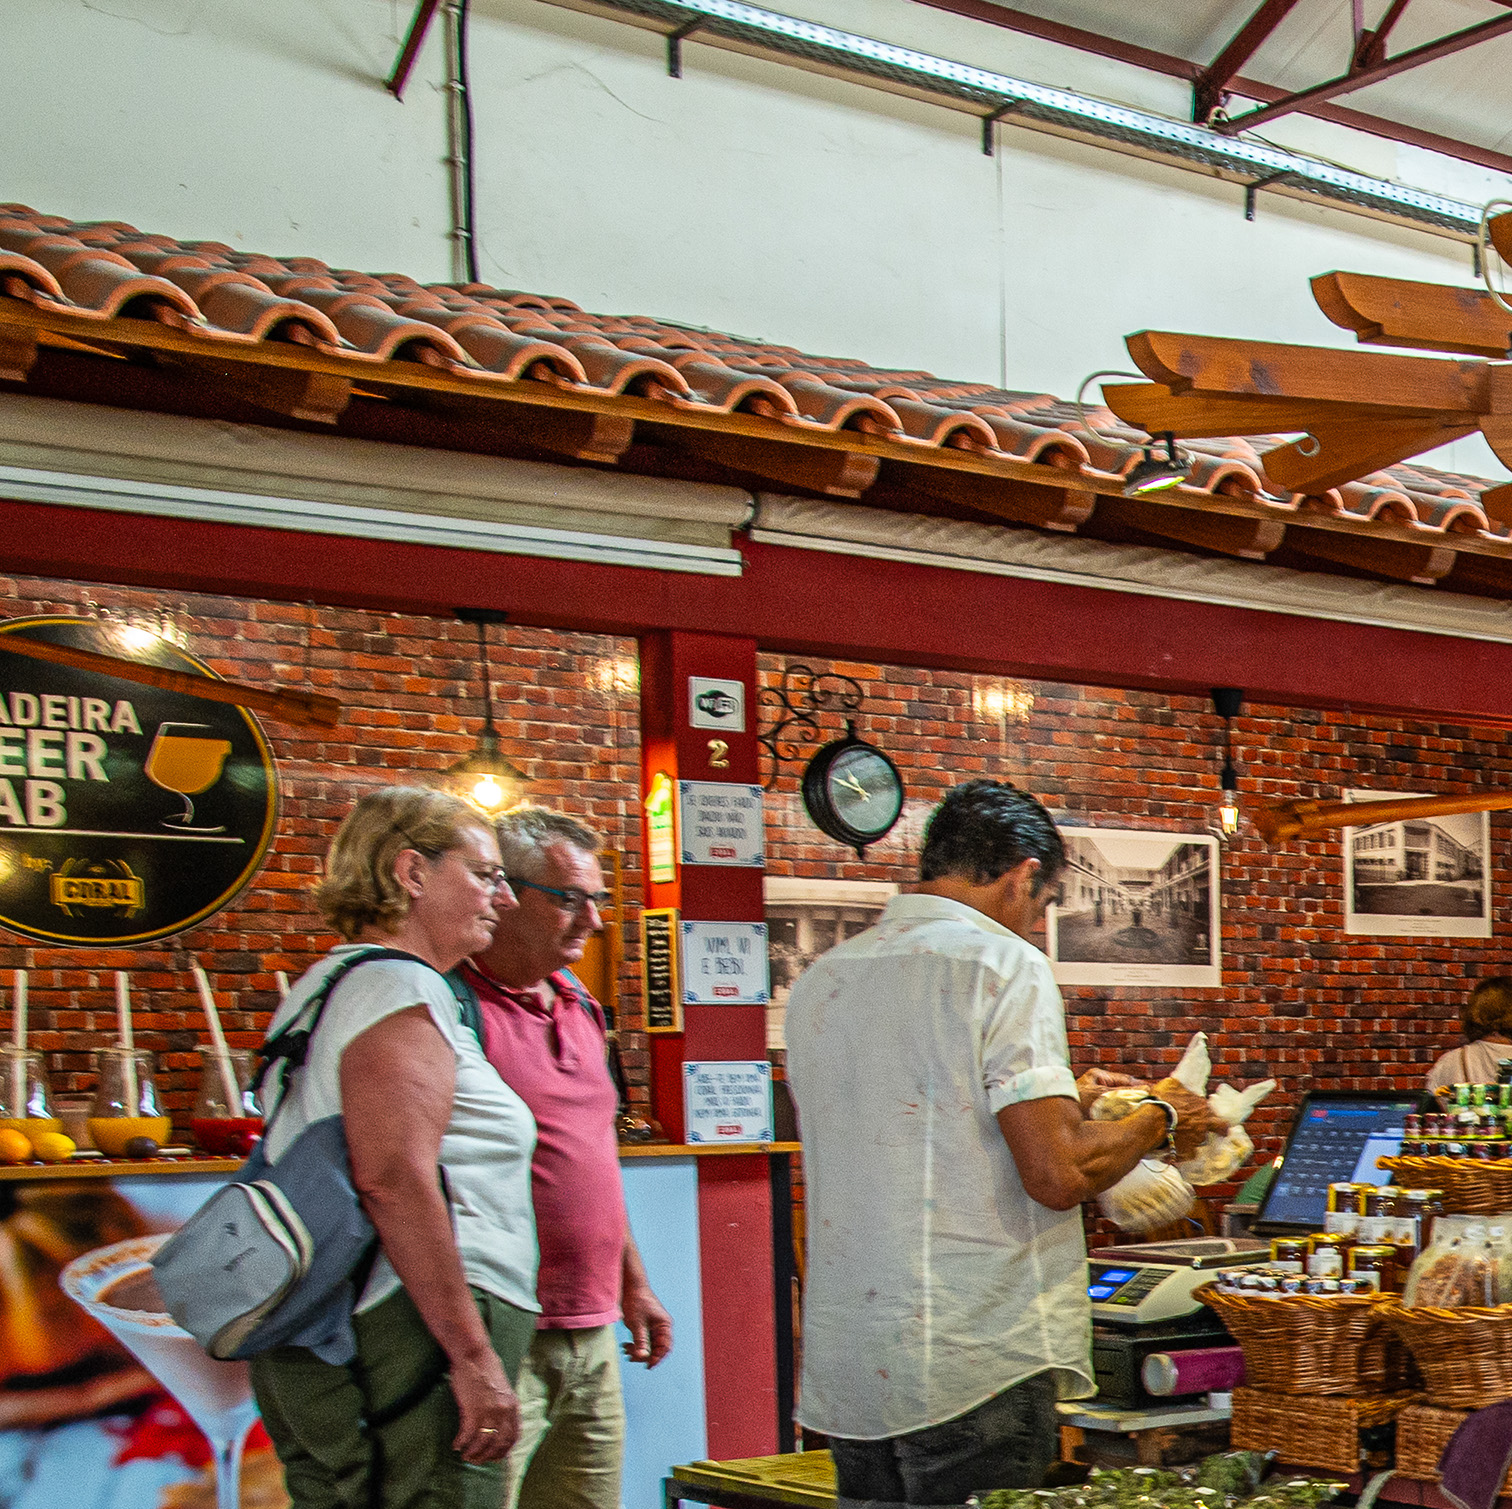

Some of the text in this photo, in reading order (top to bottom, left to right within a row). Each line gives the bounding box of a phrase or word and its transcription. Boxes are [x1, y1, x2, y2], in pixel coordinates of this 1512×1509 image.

[0, 691, 143, 736] DEIRA
[0, 726, 110, 782] EER
[707, 738, 730, 769] 2
[0, 778, 68, 827] AB
[63, 880, 133, 899] CORAL
